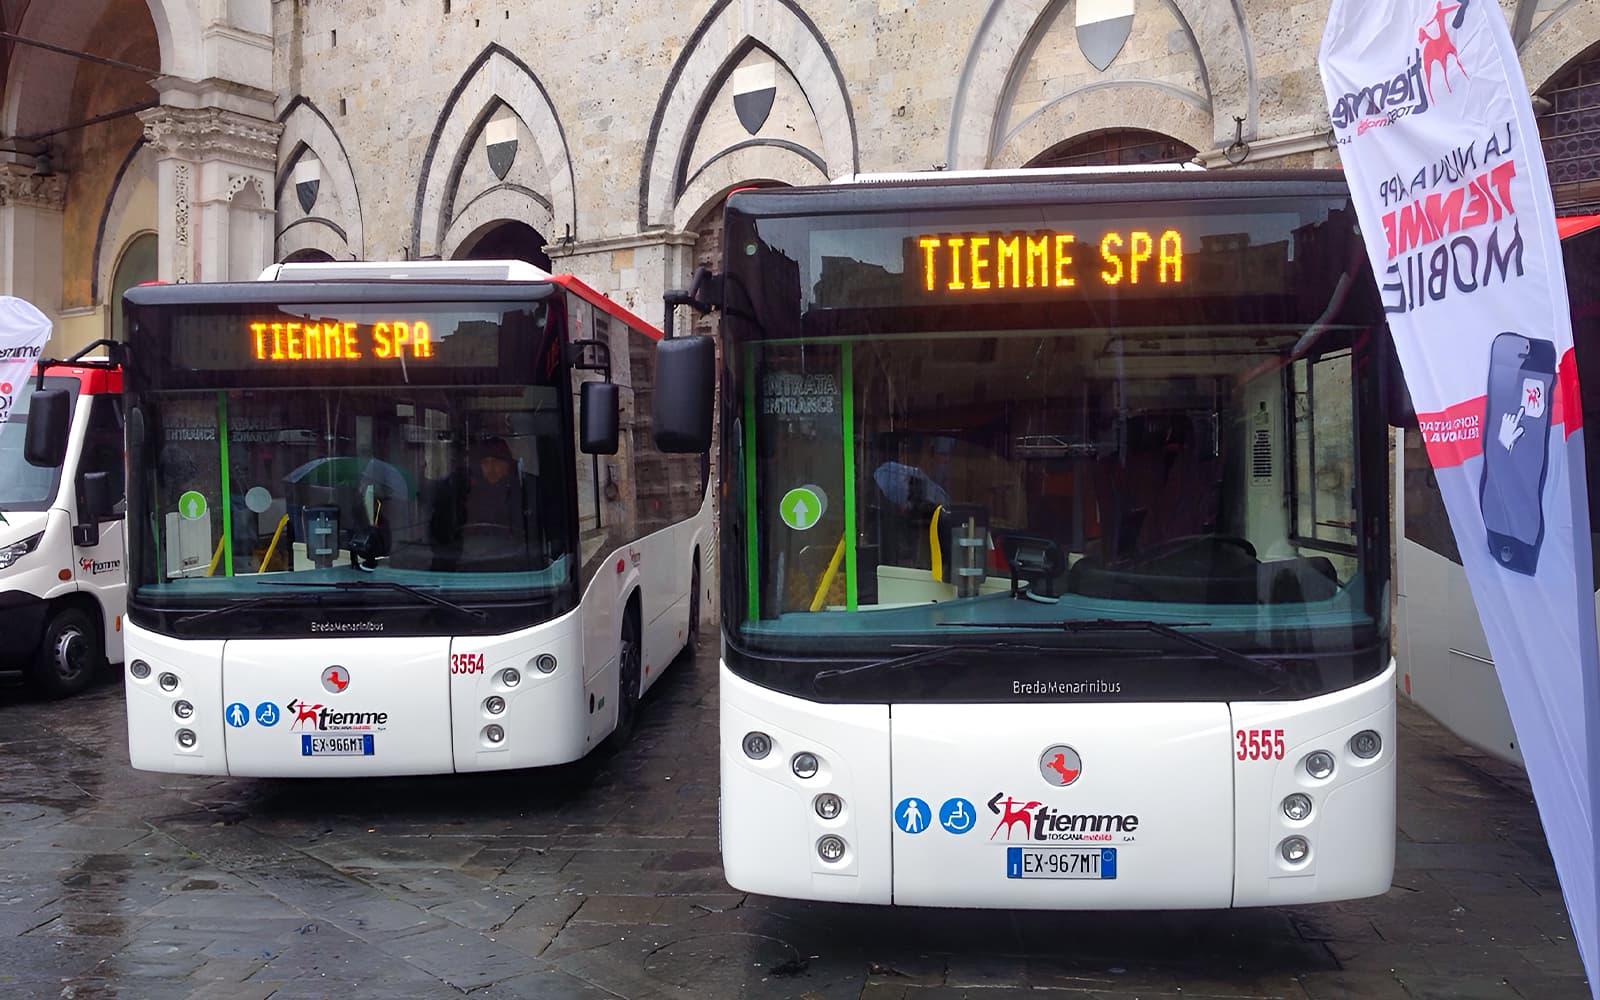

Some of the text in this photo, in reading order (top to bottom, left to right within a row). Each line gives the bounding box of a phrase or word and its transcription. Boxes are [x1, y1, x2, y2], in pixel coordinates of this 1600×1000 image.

[919, 230, 1182, 291] TIEMME SPA
[249, 320, 434, 360] TIEMME SPA
[451, 653, 484, 674] 3554
[1013, 679, 1121, 694] BredaMenarinibus
[319, 707, 387, 731] tiemme
[1236, 729, 1285, 761] 3555
[1034, 805, 1139, 841] tiemme
